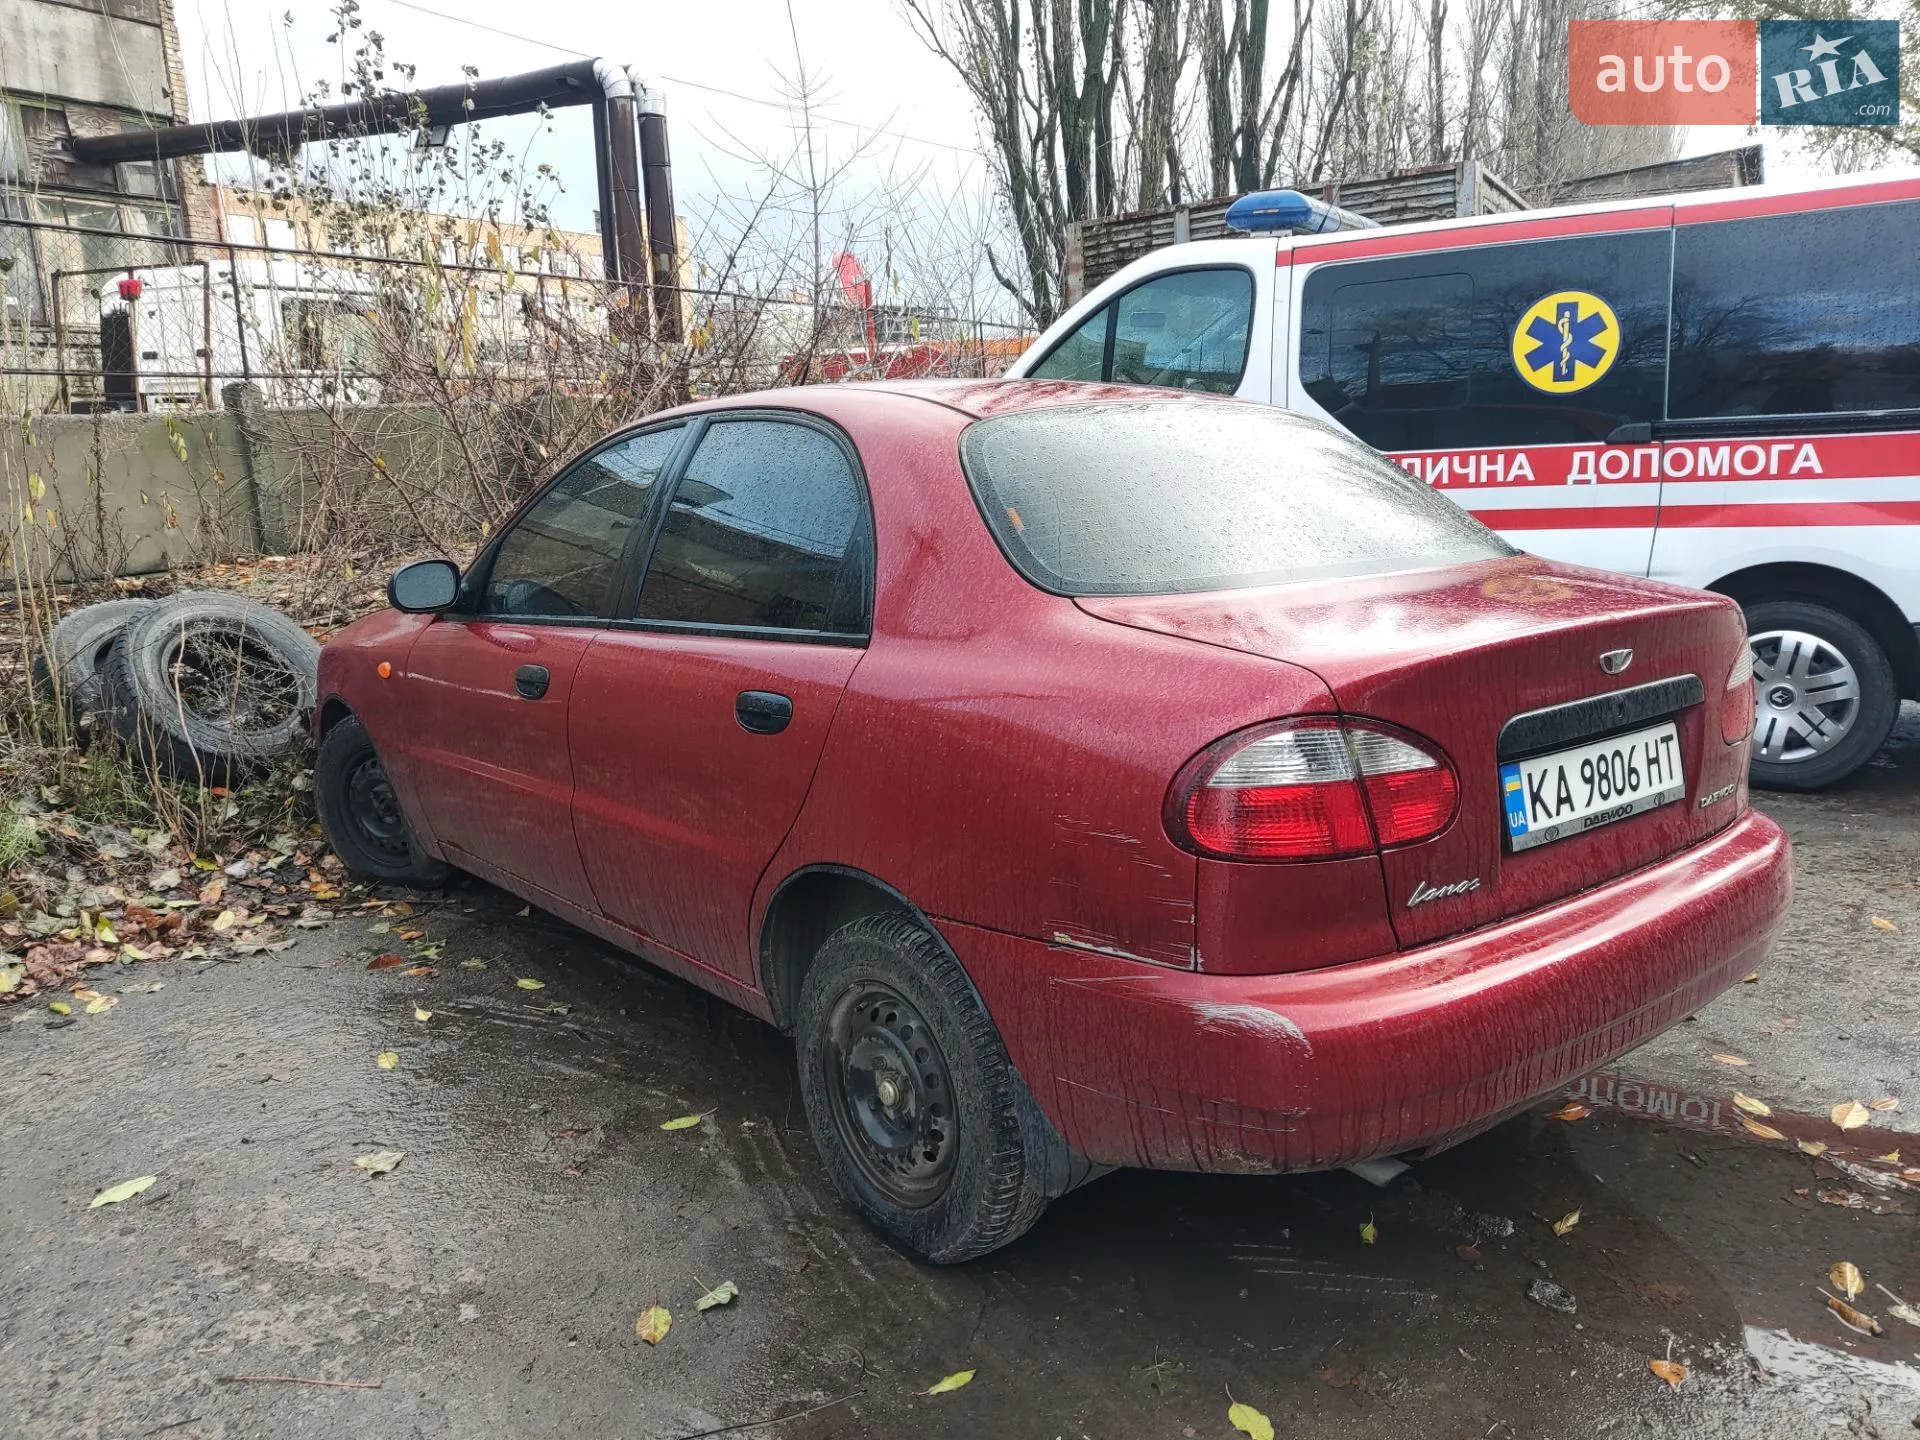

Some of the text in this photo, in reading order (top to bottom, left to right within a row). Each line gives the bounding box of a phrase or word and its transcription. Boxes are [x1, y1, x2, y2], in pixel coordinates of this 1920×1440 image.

[1567, 443, 1824, 486] ДОПОМОГА
[1526, 733, 1676, 823] KA 9806 HT
[1700, 783, 1735, 808] DAEWOO
[1509, 810, 1527, 828] UA
[1583, 803, 1633, 829] DAEWOO
